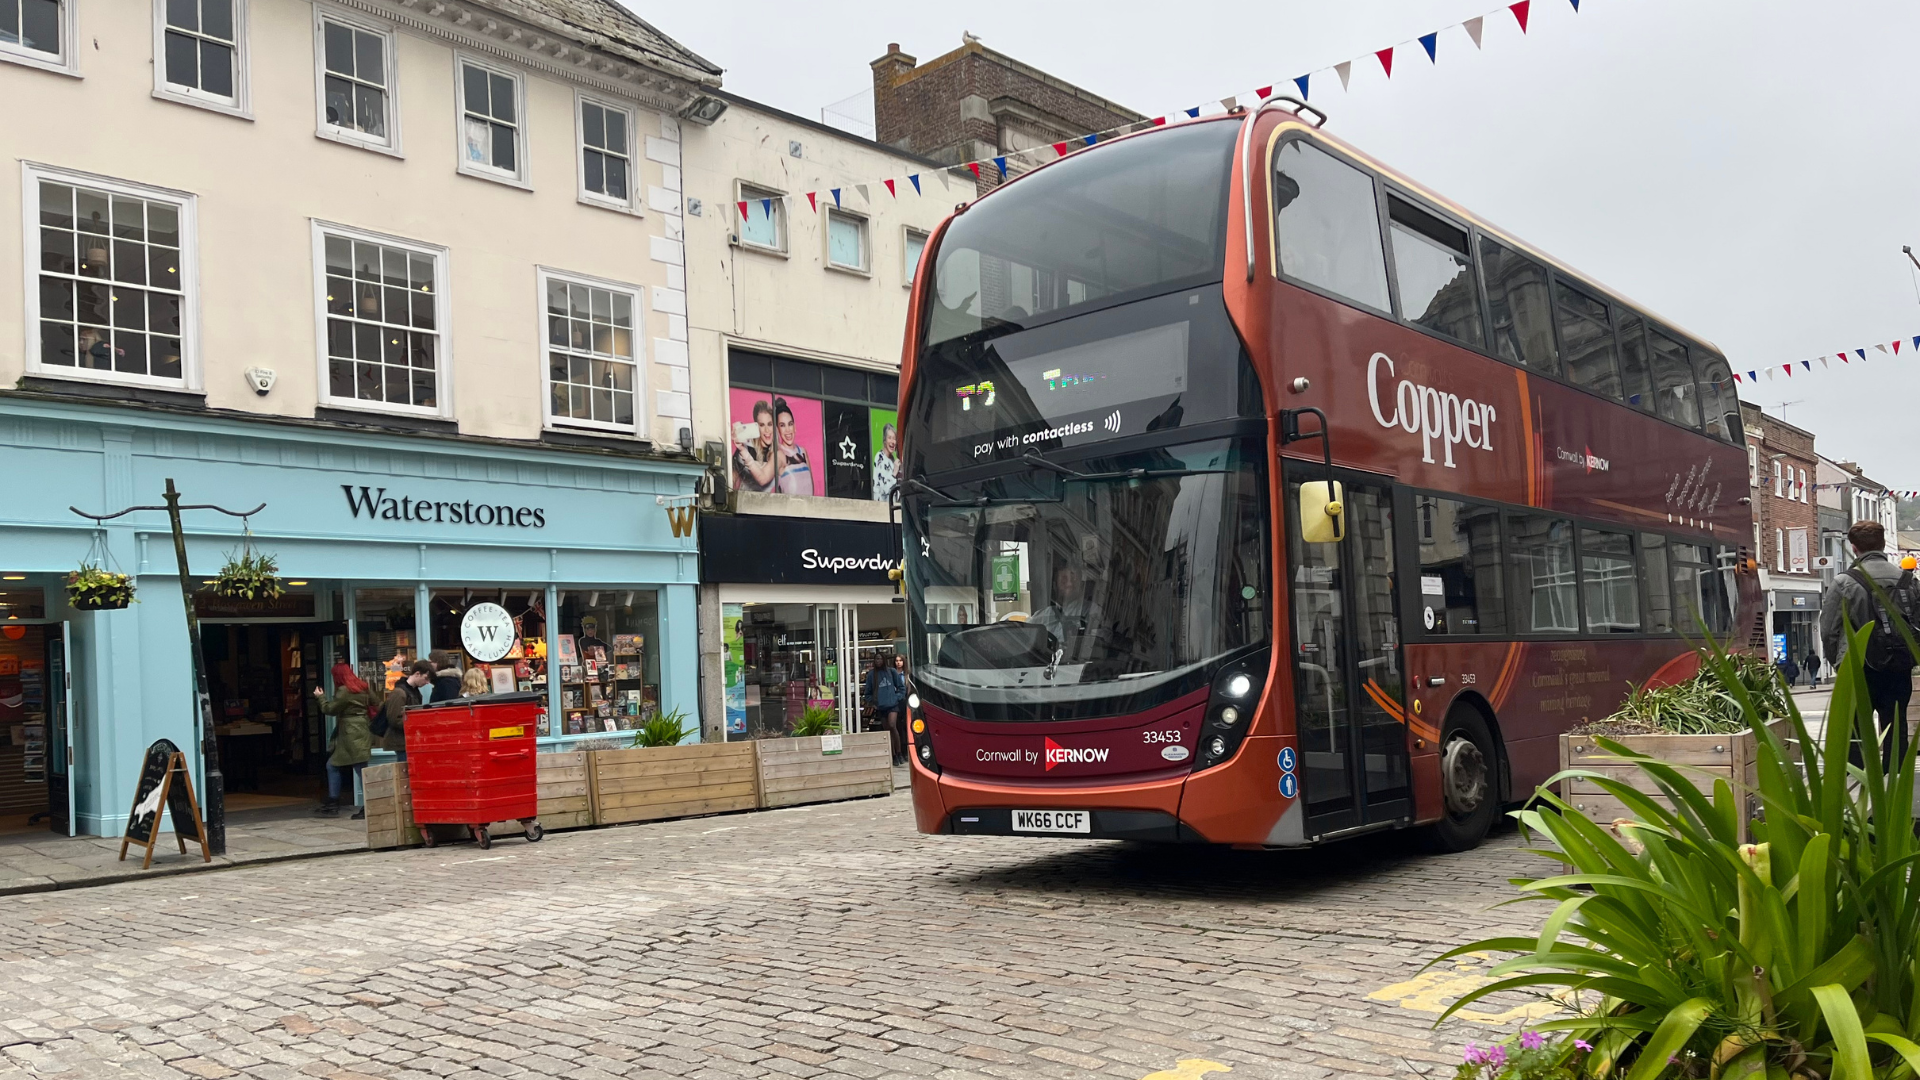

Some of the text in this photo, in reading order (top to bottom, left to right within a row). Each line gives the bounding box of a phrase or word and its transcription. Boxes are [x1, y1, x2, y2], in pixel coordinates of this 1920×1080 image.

[1367, 352, 1496, 468] Copper
[974, 421, 1094, 458] pay with contactless
[832, 459, 864, 469] Superdrug
[1557, 446, 1610, 471] Cornwall by KERNOW
[340, 484, 546, 528] Waterstones
[665, 505, 697, 538] W
[801, 548, 904, 574] Superdr
[464, 605, 512, 660] COFFEE TEA LUNCH CAKE
[477, 625, 499, 642] W
[1461, 673, 1476, 684] 33453
[1142, 730, 1182, 744] 33453
[976, 748, 1109, 765] Cornwall by KERNOW
[1017, 812, 1083, 829] WK66 CCF
